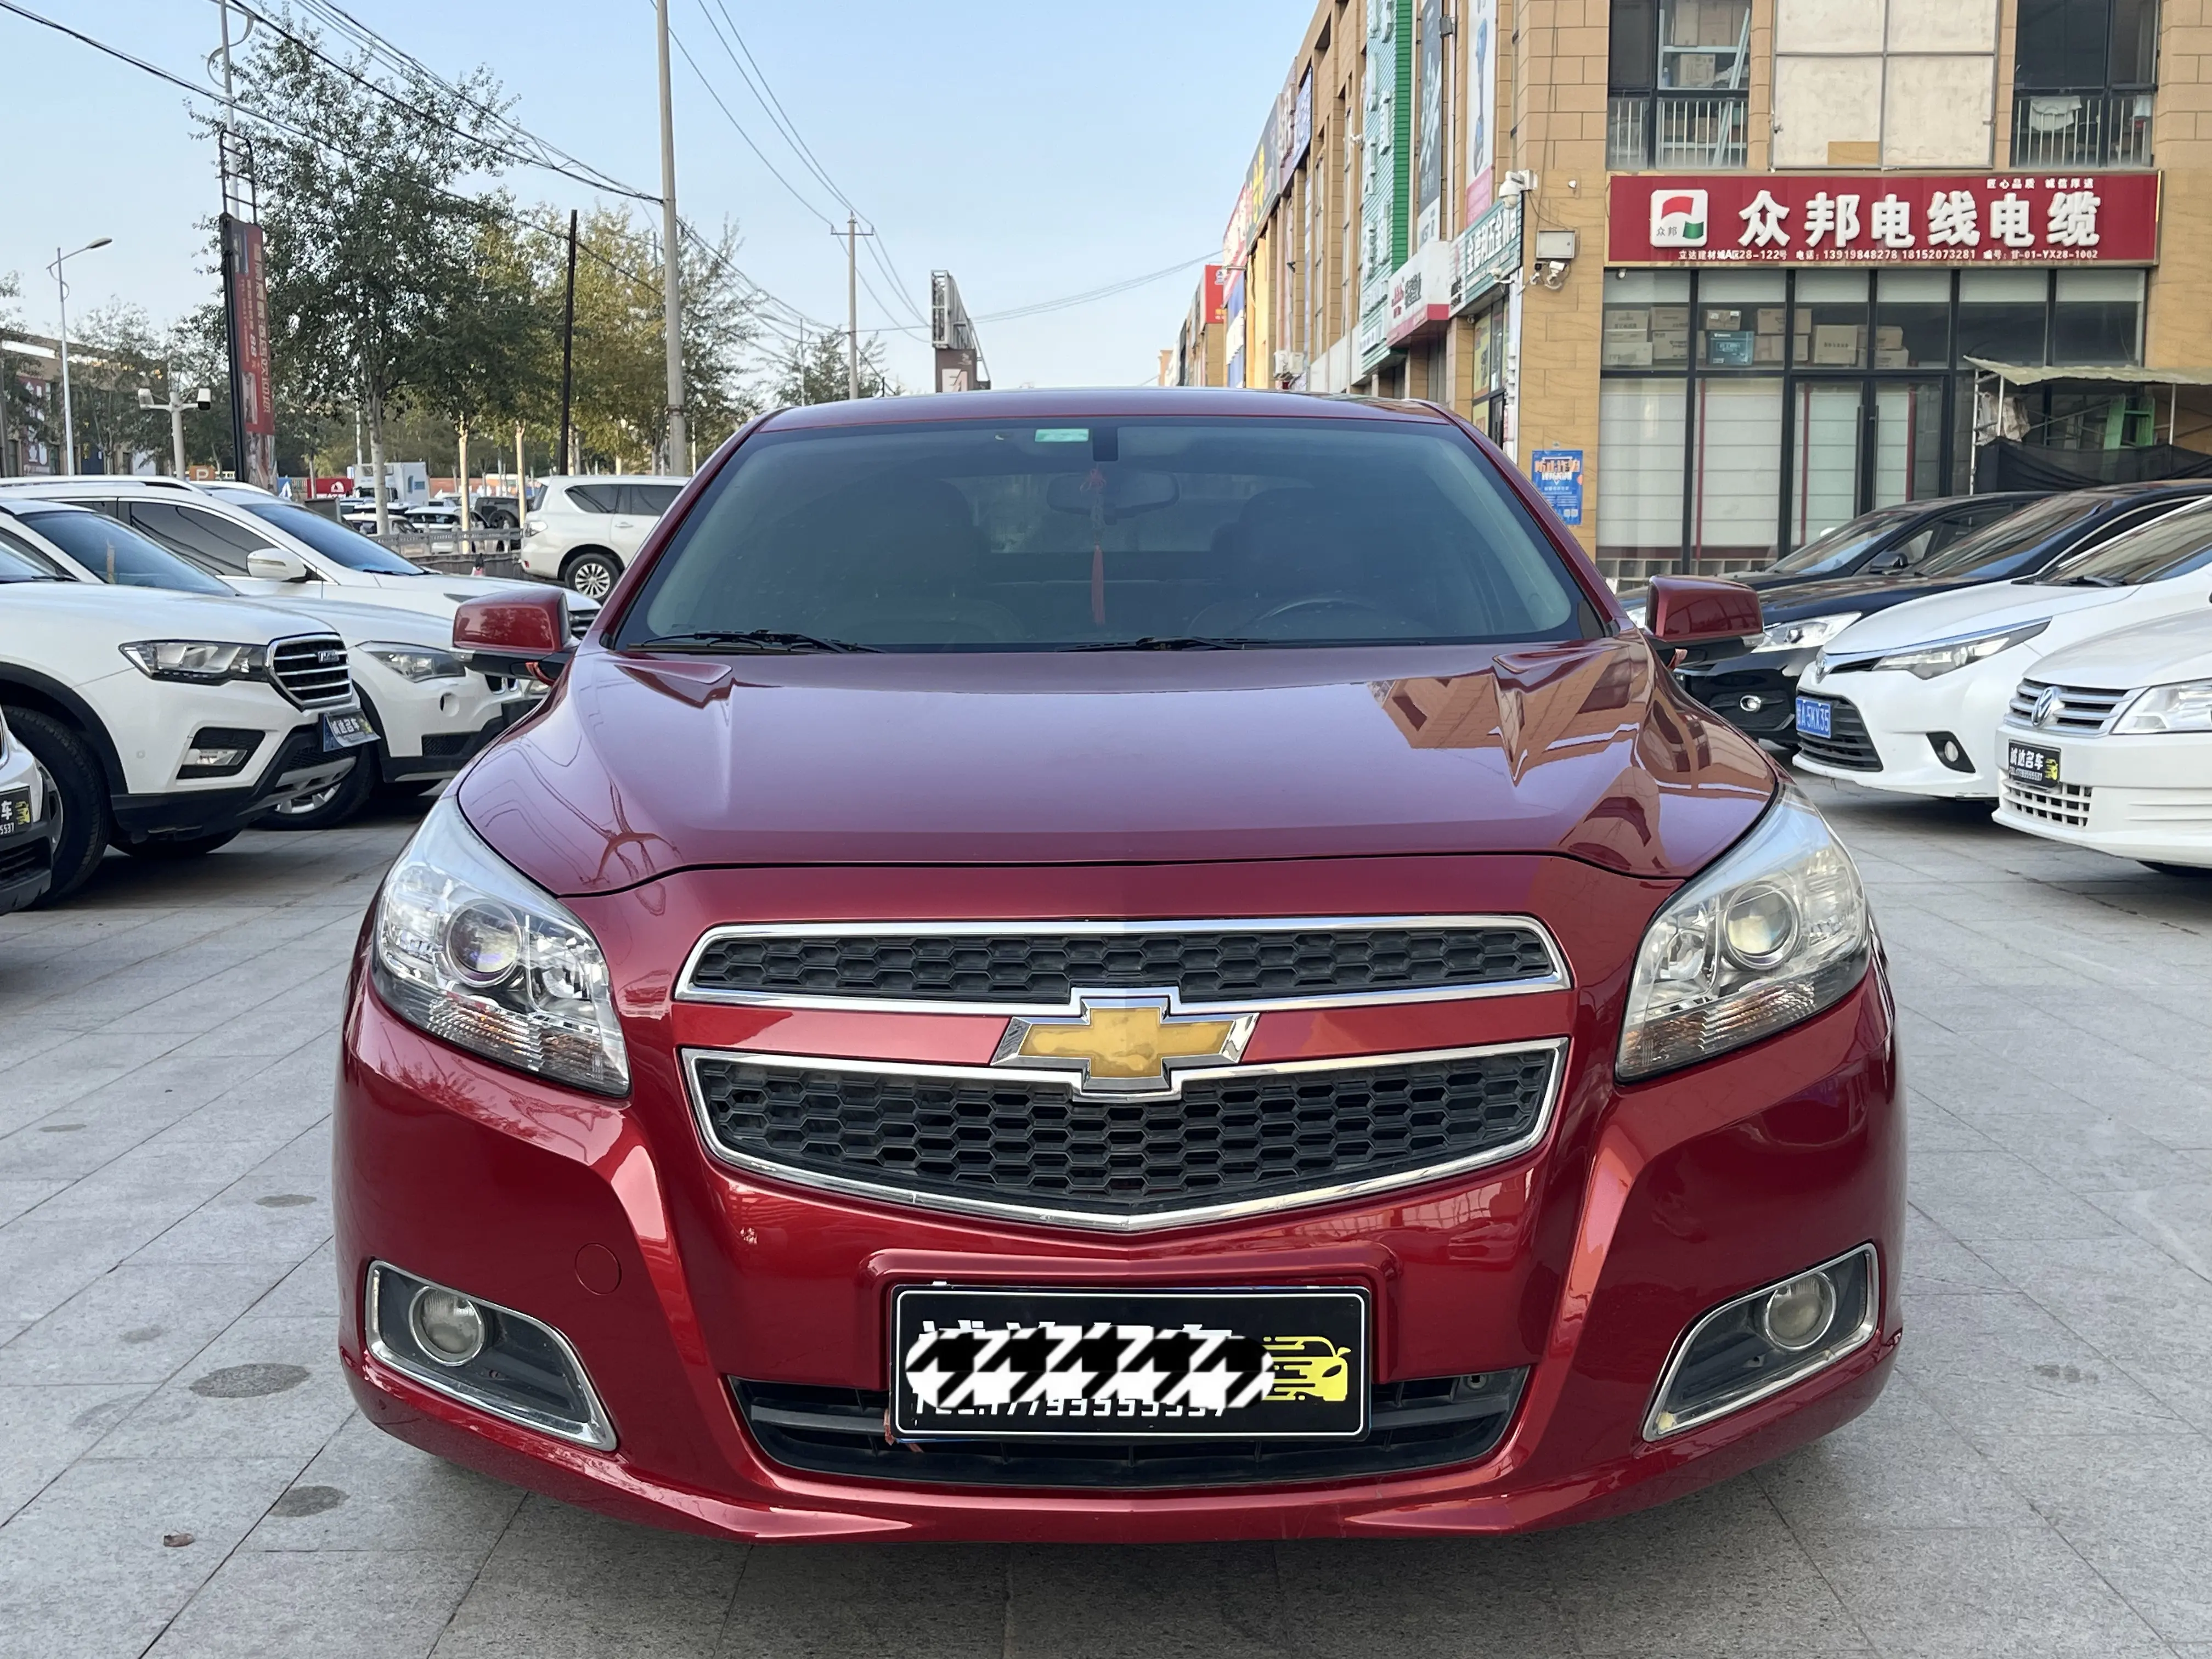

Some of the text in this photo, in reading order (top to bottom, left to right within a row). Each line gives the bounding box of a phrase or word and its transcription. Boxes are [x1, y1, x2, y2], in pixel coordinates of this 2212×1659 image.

[1738, 189, 2101, 248] 众邦电线电缆
[1656, 226, 1678, 237] 众邦
[1678, 249, 1787, 260] 立达建材城A区28-122号
[1901, 249, 1976, 259] 18152073281
[196, 469, 209, 481] P
[1, 800, 12, 820] 车
